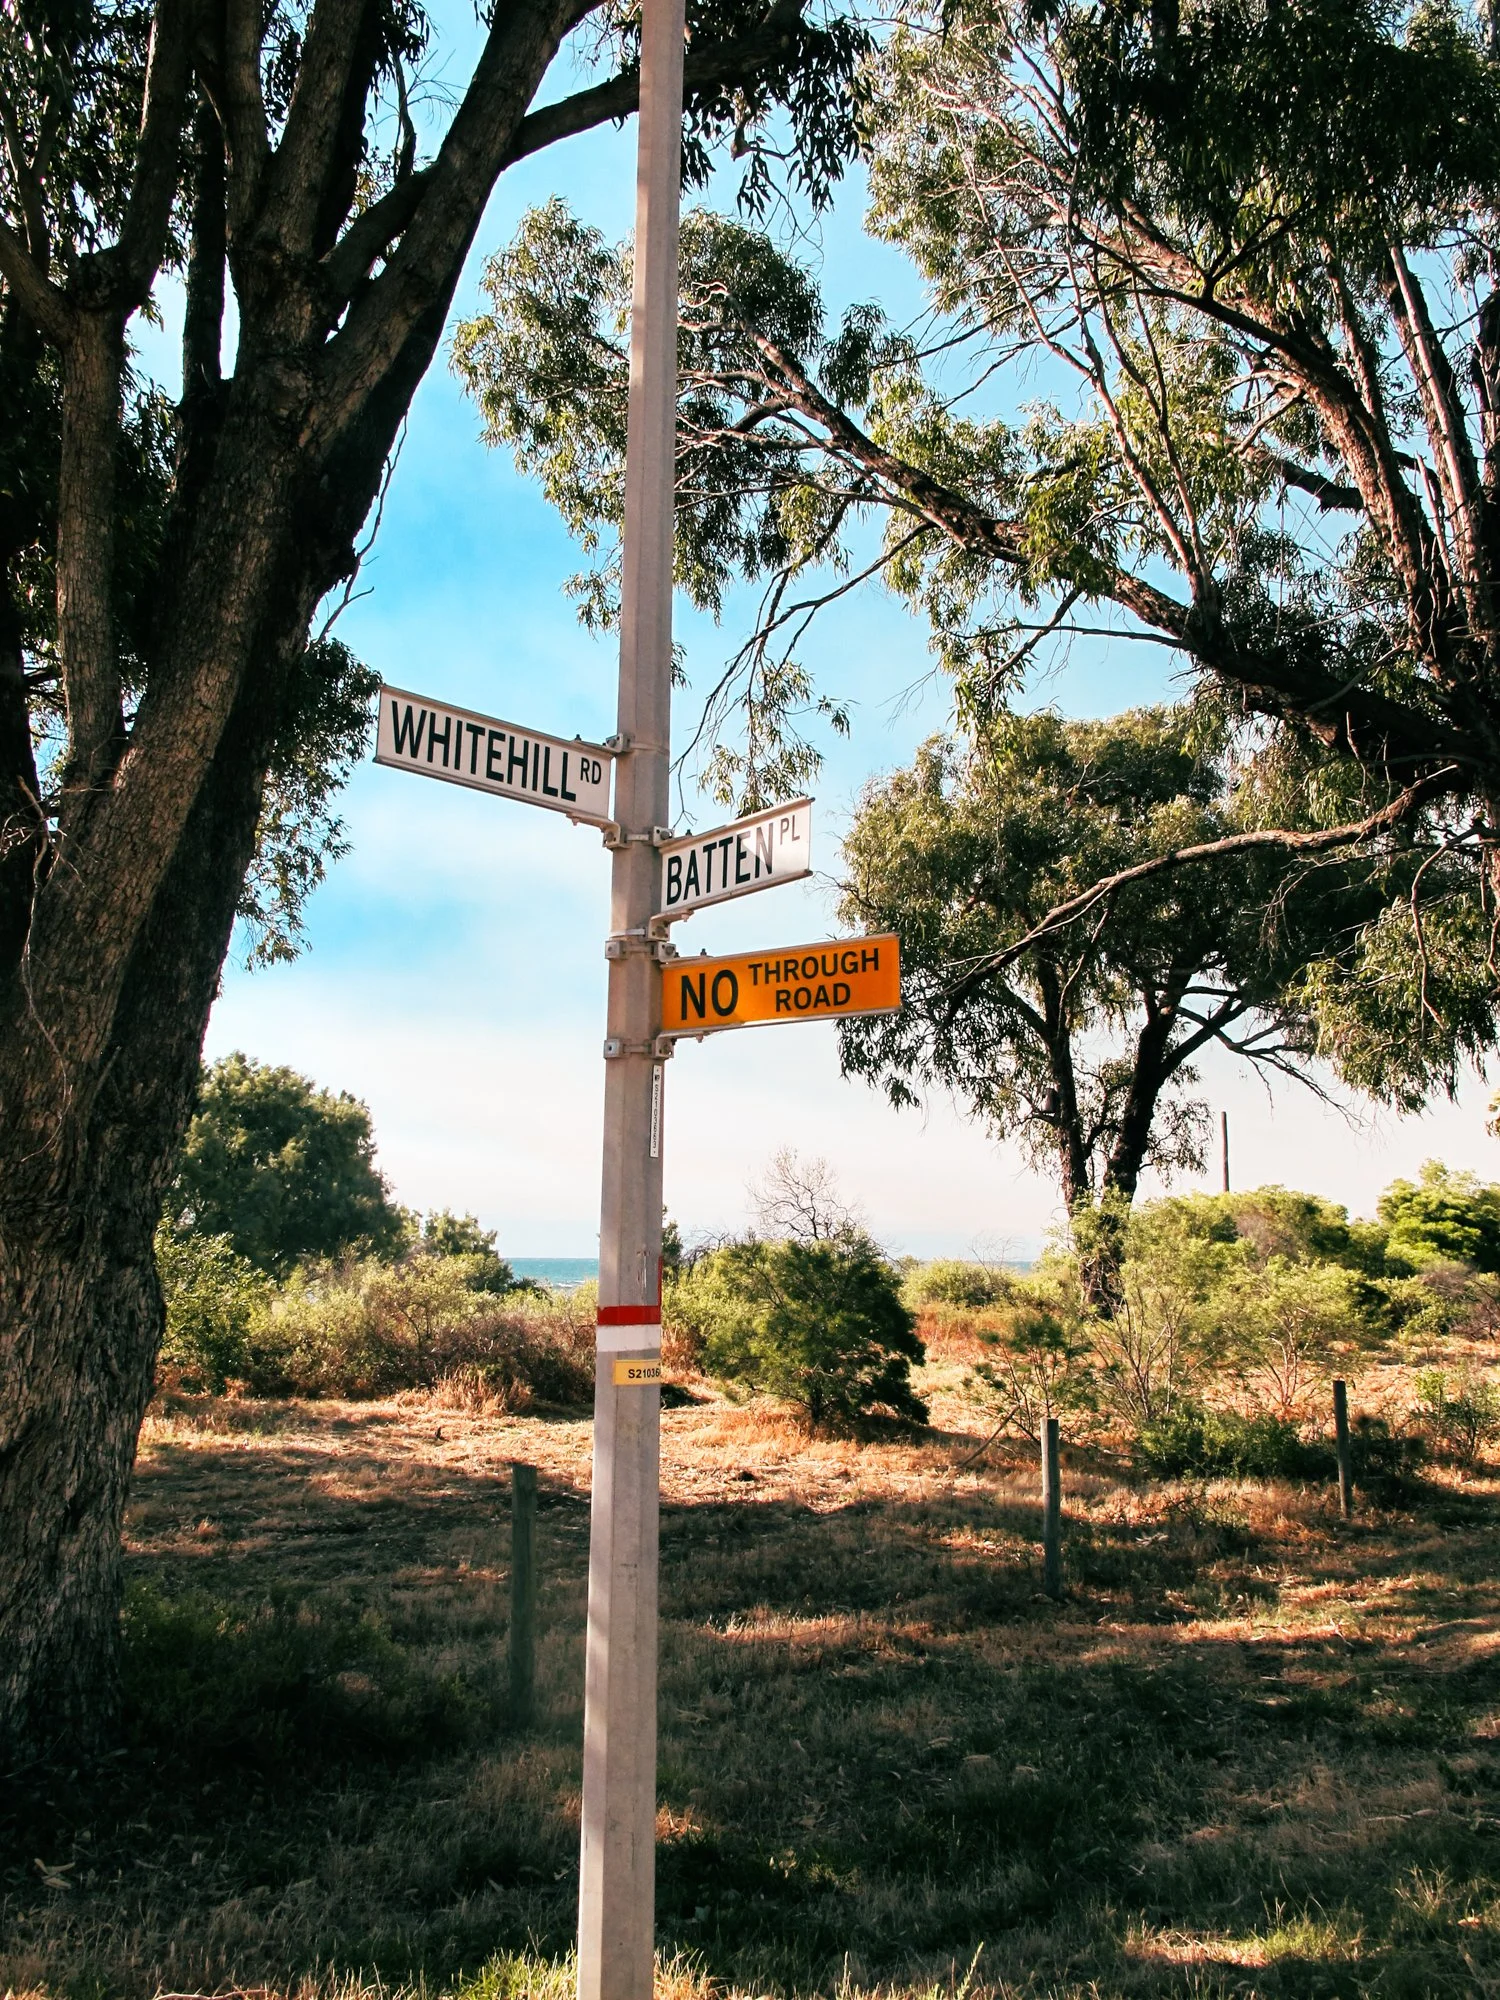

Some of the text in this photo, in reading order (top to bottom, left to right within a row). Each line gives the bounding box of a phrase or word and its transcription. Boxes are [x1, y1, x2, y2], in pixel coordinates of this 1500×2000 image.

[391, 700, 601, 802] WHITEHILL RD
[666, 814, 801, 906] BATTEN PL
[748, 947, 879, 986] THROUGH
[680, 969, 739, 1021] NO
[775, 982, 851, 1012] ROAD
